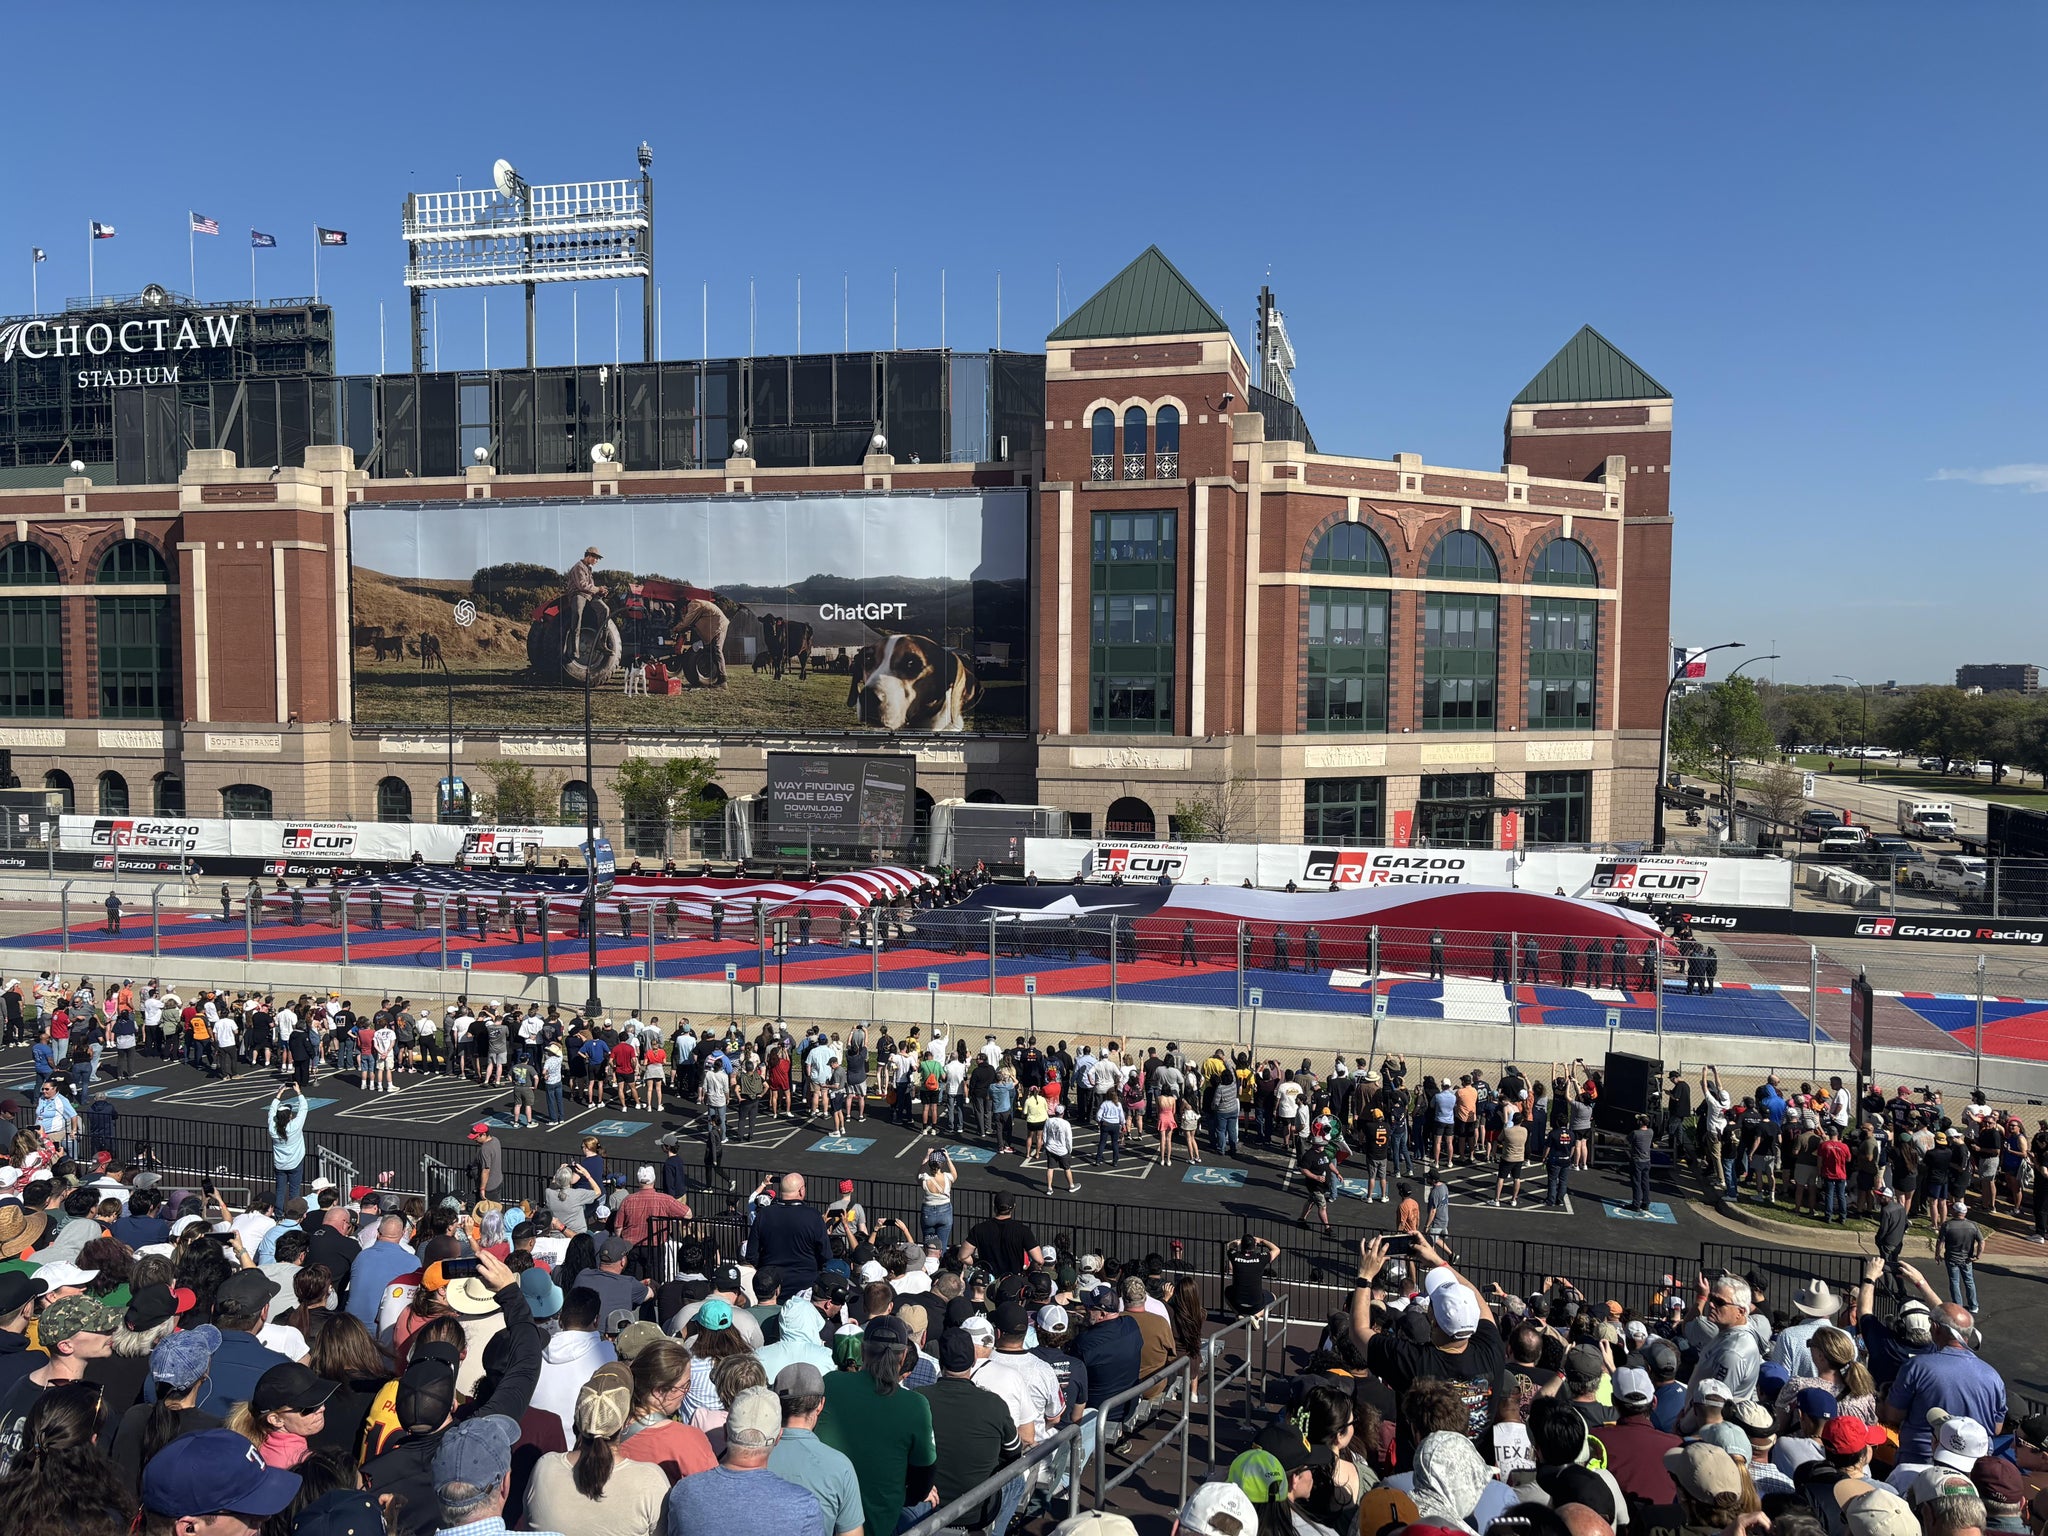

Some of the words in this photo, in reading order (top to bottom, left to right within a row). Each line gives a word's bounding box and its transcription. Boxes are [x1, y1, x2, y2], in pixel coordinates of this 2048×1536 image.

[20, 315, 239, 359] CHOCTAW
[78, 366, 180, 388] STADIUM
[819, 602, 908, 621] ChatGPT
[774, 781, 802, 791] WAY
[804, 782, 855, 792] FINDING
[774, 791, 815, 801] MADE
[816, 793, 853, 802] EASY
[784, 804, 843, 813] DOWNLOAD
[136, 823, 200, 836] GAZOO
[92, 829, 132, 846] GR
[134, 836, 197, 851] Racing
[283, 835, 312, 848] GR
[313, 837, 353, 849] CUP
[1161, 843, 1188, 851] Racing
[94, 860, 114, 869] GR
[117, 860, 157, 870] GAZOO
[1129, 859, 1182, 874] CUP
[1372, 855, 1466, 870] GAZOO
[1599, 856, 1637, 864] TOYOTA
[1638, 857, 1675, 865] GAZOO
[1675, 858, 1708, 867] Racing
[264, 864, 285, 875] GR
[288, 865, 331, 875] GAOO
[1306, 863, 1362, 882] GR
[1368, 870, 1460, 884] Racing
[1592, 872, 1634, 888] GR
[1638, 874, 1701, 889] CUP
[1857, 923, 1892, 936] GR
[1898, 925, 1972, 938] GAZOO
[1975, 928, 2044, 943] Racing
[1376, 1130, 1388, 1145] 5
[245, 1444, 266, 1471] T
